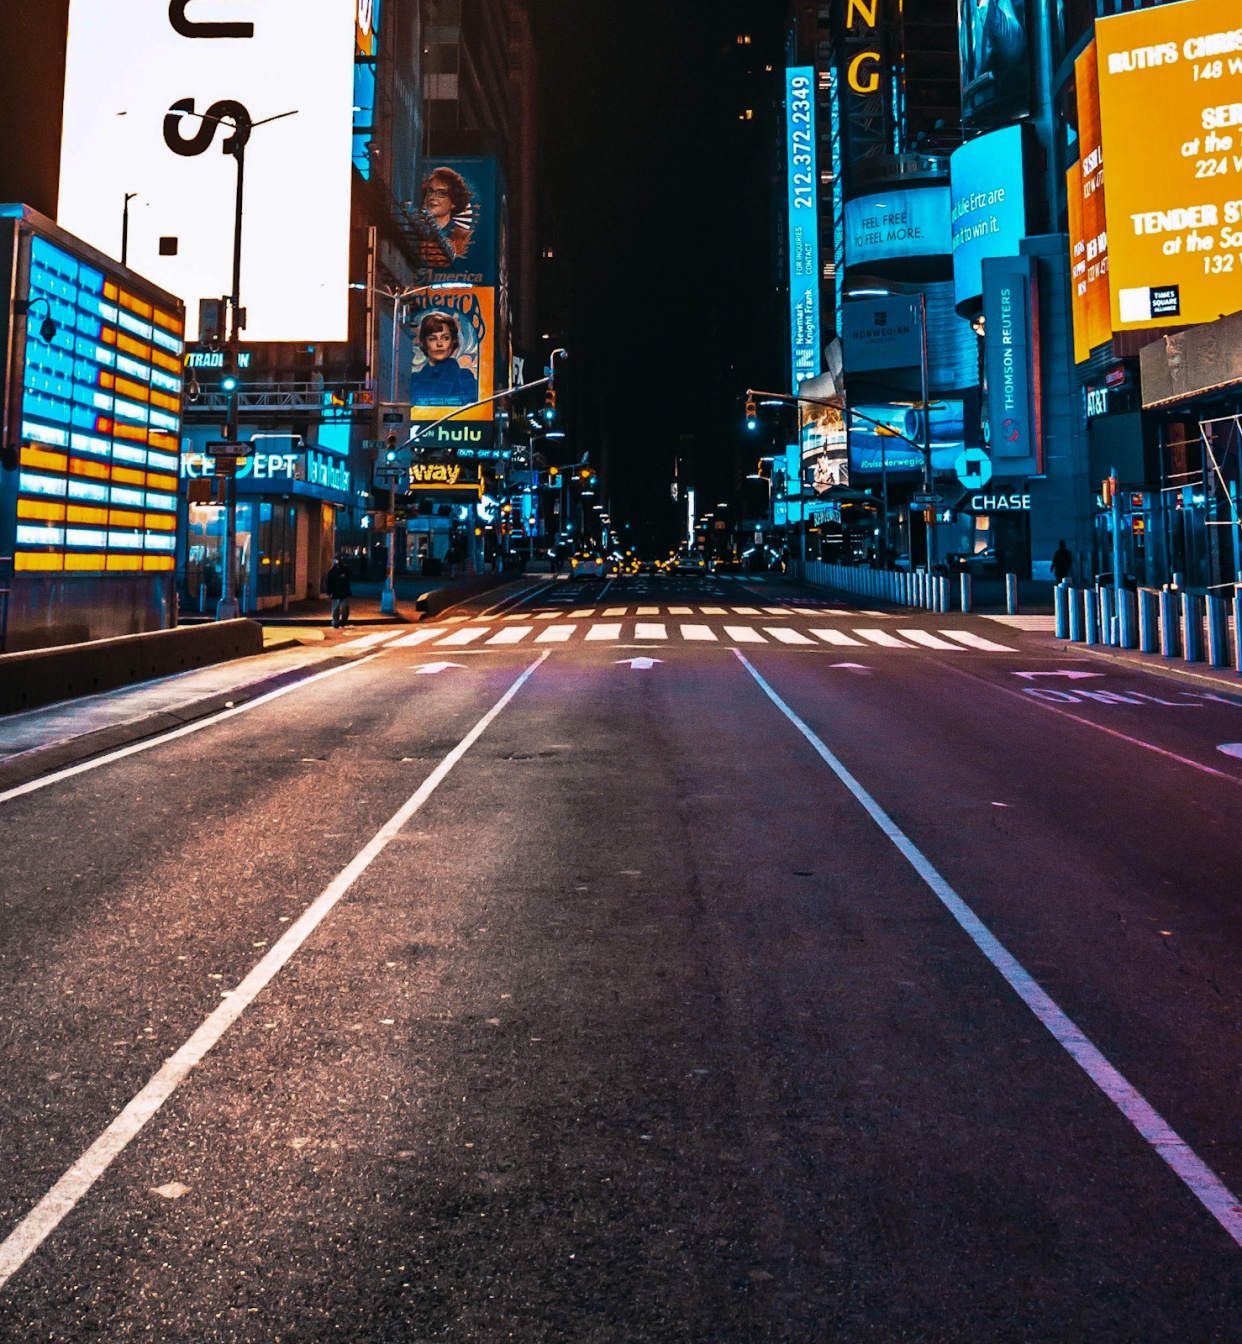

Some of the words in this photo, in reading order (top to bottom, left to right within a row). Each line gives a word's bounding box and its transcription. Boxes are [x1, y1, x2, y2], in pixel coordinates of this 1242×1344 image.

[1193, 60, 1222, 81] 148
[791, 77, 812, 209] 212.372.2349
[1181, 137, 1200, 157] at
[1205, 130, 1232, 153] the
[1195, 156, 1227, 178] 224
[970, 193, 987, 211] Ertz
[988, 188, 1005, 204] are
[862, 217, 879, 230] FEEL
[883, 212, 907, 226] FREE
[973, 219, 988, 238] win
[1130, 204, 1218, 235] TENDER
[855, 235, 863, 247] TO
[865, 232, 883, 245] FEEL
[887, 227, 924, 241] MORE.
[1162, 236, 1181, 255] at
[1186, 229, 1214, 252] the
[1204, 253, 1234, 274] 132
[804, 289, 812, 313] Frank
[795, 303, 803, 344] Newmark
[1001, 288, 1012, 344] REUTERS
[805, 316, 815, 344] Knight
[853, 326, 910, 339] NORWEGIAN
[1003, 348, 1014, 411] THOMSON
[1087, 388, 1108, 417] AT&T
[438, 426, 481, 441] hulu
[180, 452, 216, 478] ICE
[971, 494, 1031, 510] CHASE
[1021, 688, 1242, 706] ONLY
